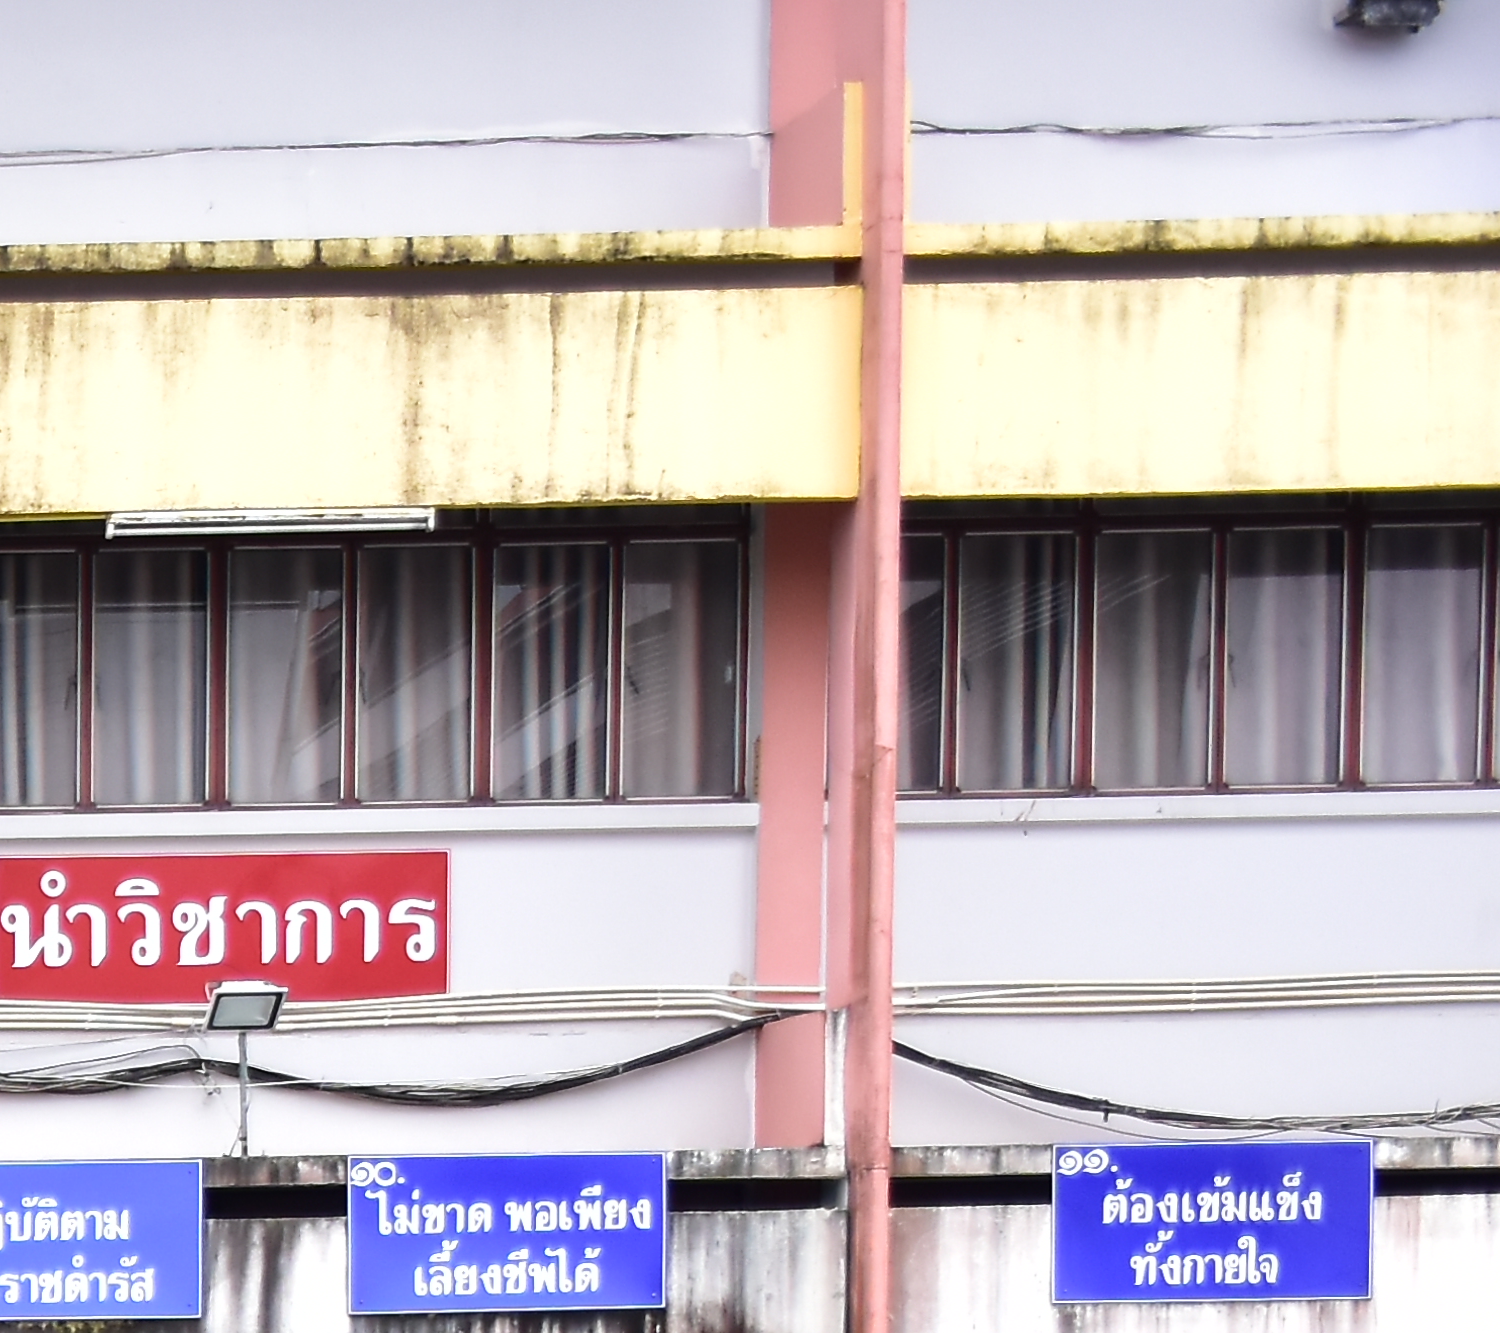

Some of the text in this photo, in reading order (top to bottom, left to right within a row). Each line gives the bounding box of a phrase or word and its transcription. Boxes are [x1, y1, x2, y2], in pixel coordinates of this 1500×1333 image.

[1, 871, 435, 967] นำวิชาการ
[365, 1185, 652, 1235] ไม่ขาด พอเพียง
[1103, 1172, 1322, 1224] ต้องเข้มแข็ง
[414, 1239, 602, 1298] เลี้ยงชีพได้
[1130, 1230, 1279, 1285] ทั้งกายใจ
